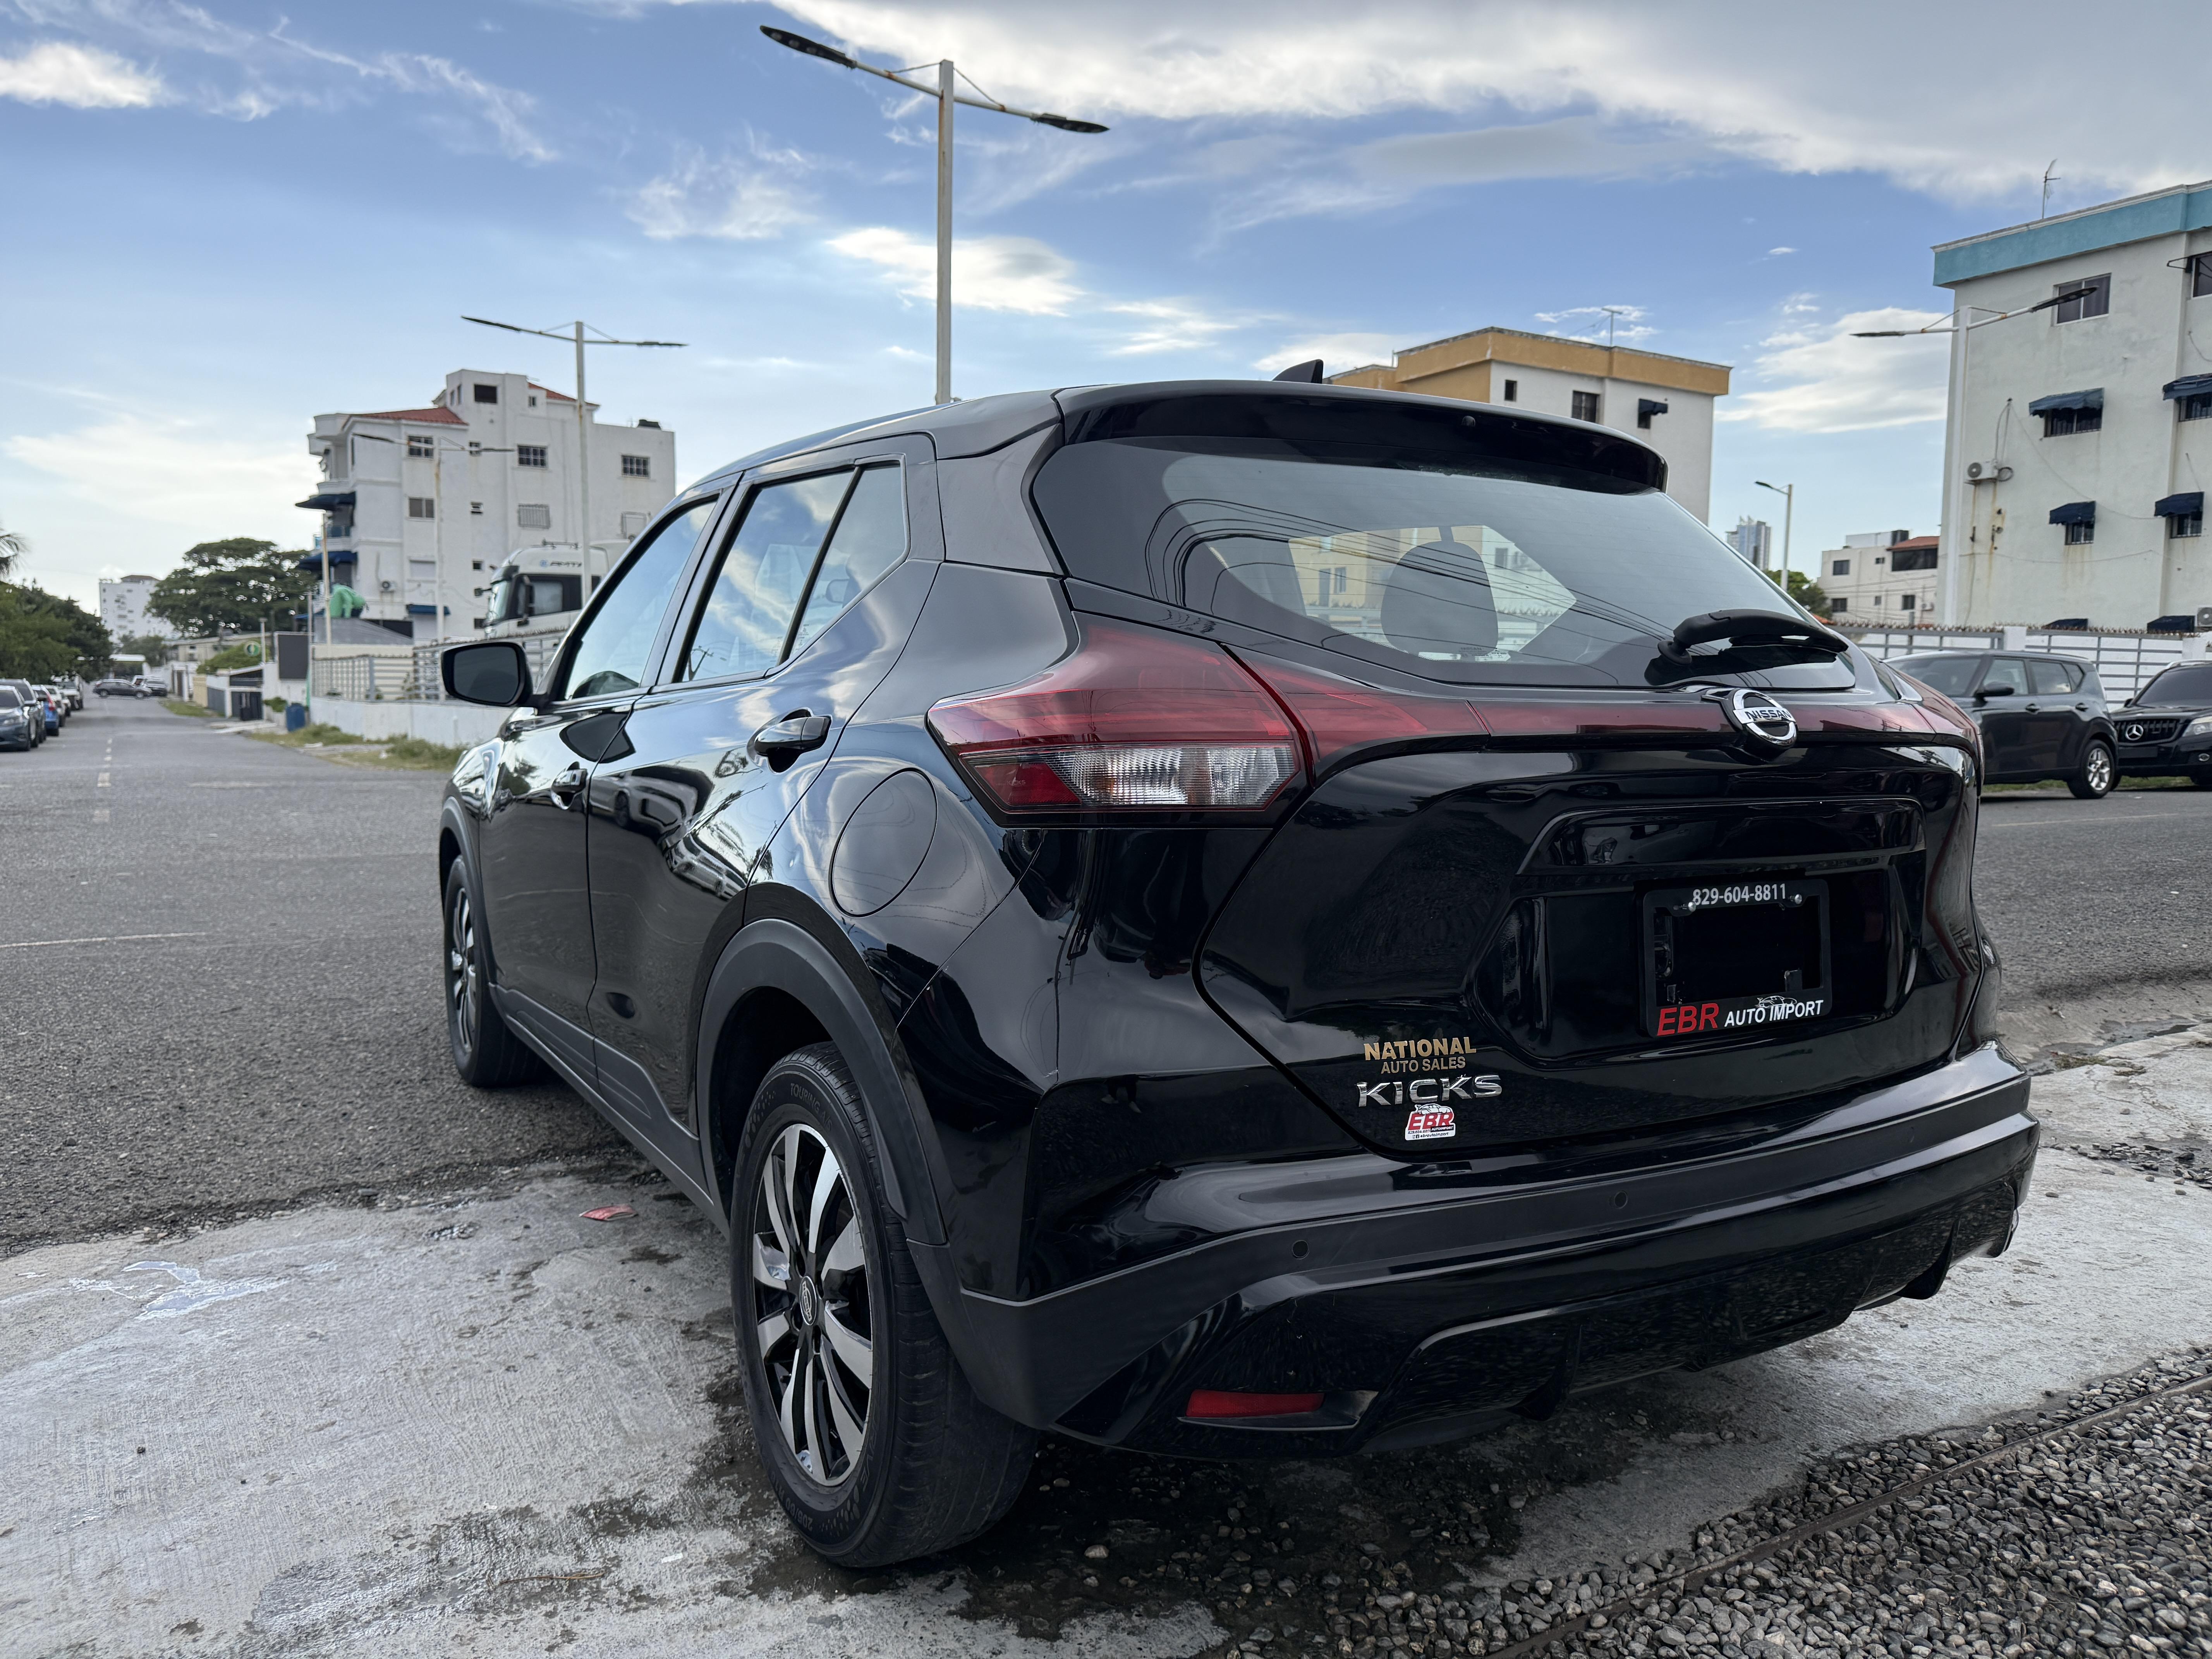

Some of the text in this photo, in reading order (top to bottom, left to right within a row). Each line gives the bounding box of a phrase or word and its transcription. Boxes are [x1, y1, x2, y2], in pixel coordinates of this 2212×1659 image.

[1745, 710, 1792, 720] NISSAN
[1692, 883, 1786, 905] 829-604-8811
[1657, 1000, 1824, 1036] EBR AUTO IMPORT
[1363, 1036, 1477, 1061] NATIONAL
[1381, 1056, 1466, 1074] AUTO SALES
[790, 1083, 820, 1114] TOURING
[1357, 1074, 1503, 1107] KICKS
[1408, 1112, 1453, 1130] EBR
